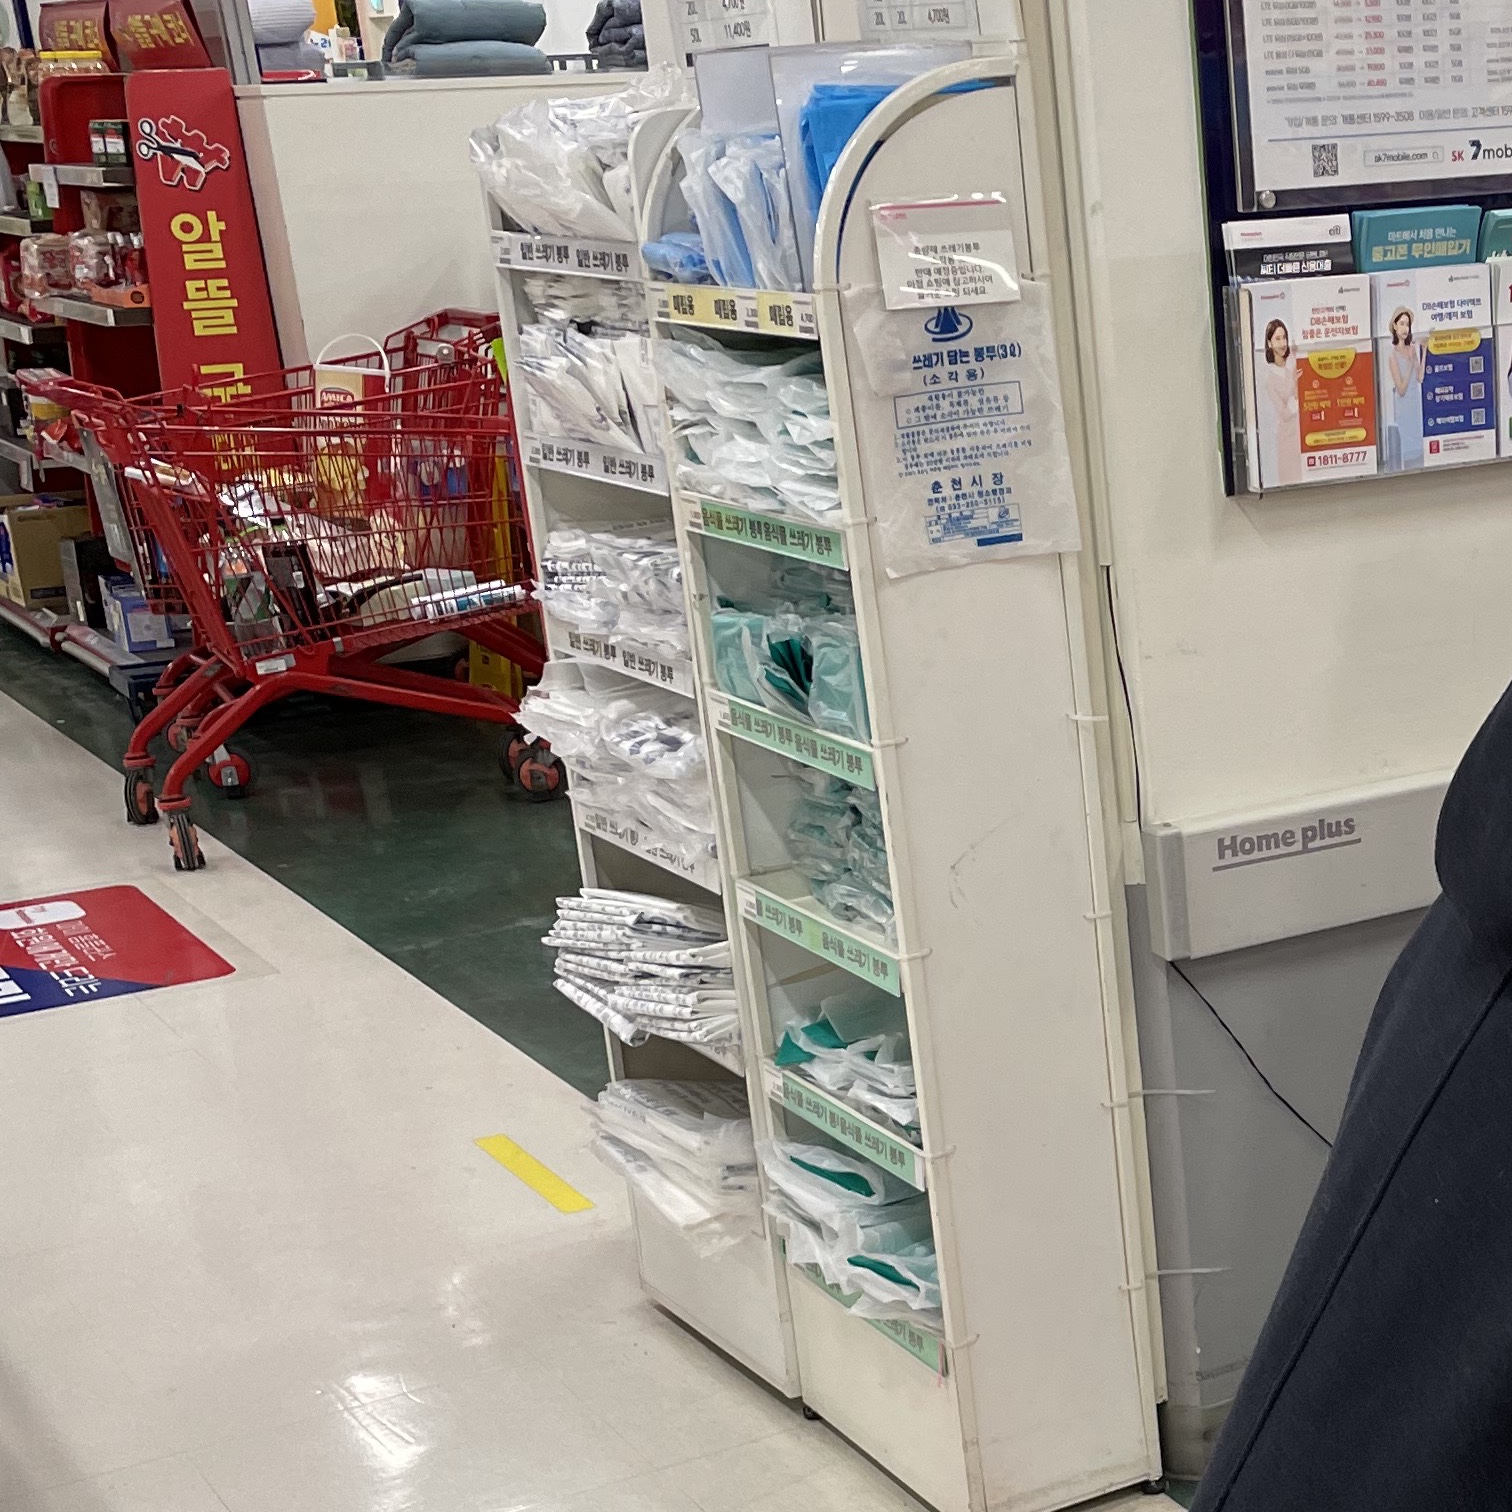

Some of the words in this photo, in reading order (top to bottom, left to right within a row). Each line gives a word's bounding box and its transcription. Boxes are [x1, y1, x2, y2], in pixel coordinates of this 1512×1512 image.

[1451, 150, 1464, 162] SK
[911, 349, 945, 371] 쓰레기
[947, 347, 971, 365] 담는
[1317, 450, 1368, 467] 1811-8777
